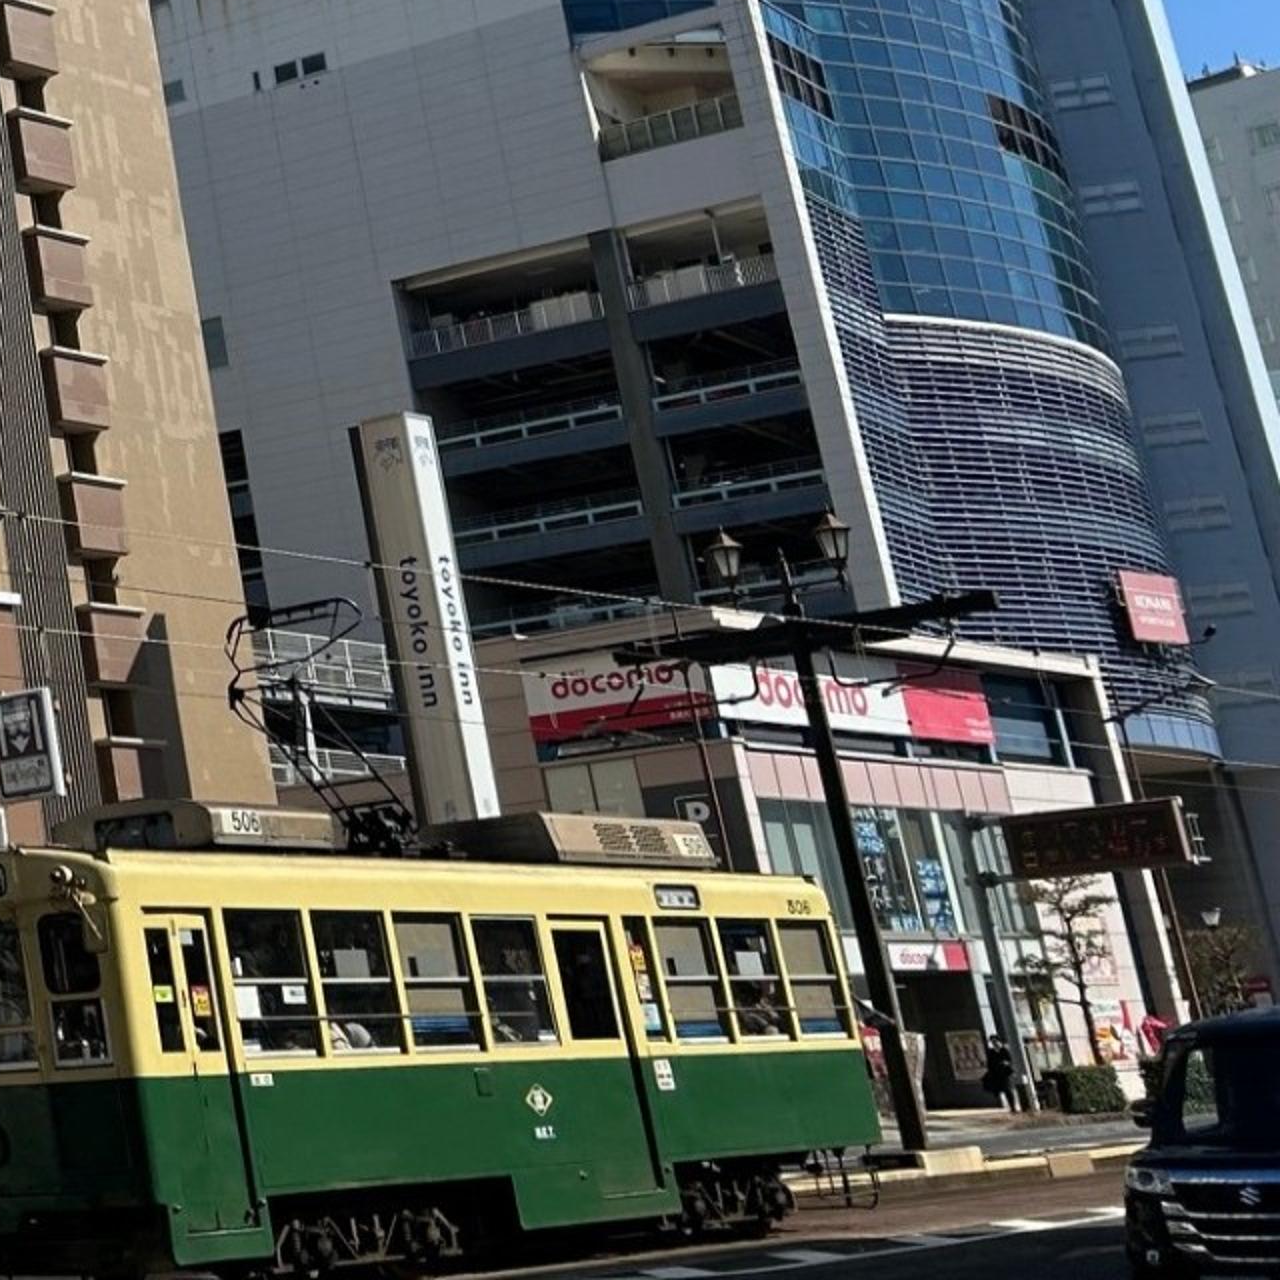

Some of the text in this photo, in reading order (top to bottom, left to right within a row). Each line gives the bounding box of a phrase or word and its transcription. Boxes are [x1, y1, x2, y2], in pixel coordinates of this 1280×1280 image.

[399, 556, 438, 708] toyoko inn
[438, 556, 472, 706] toyoko inn
[551, 663, 674, 699] docomo
[231, 811, 259, 832] 506
